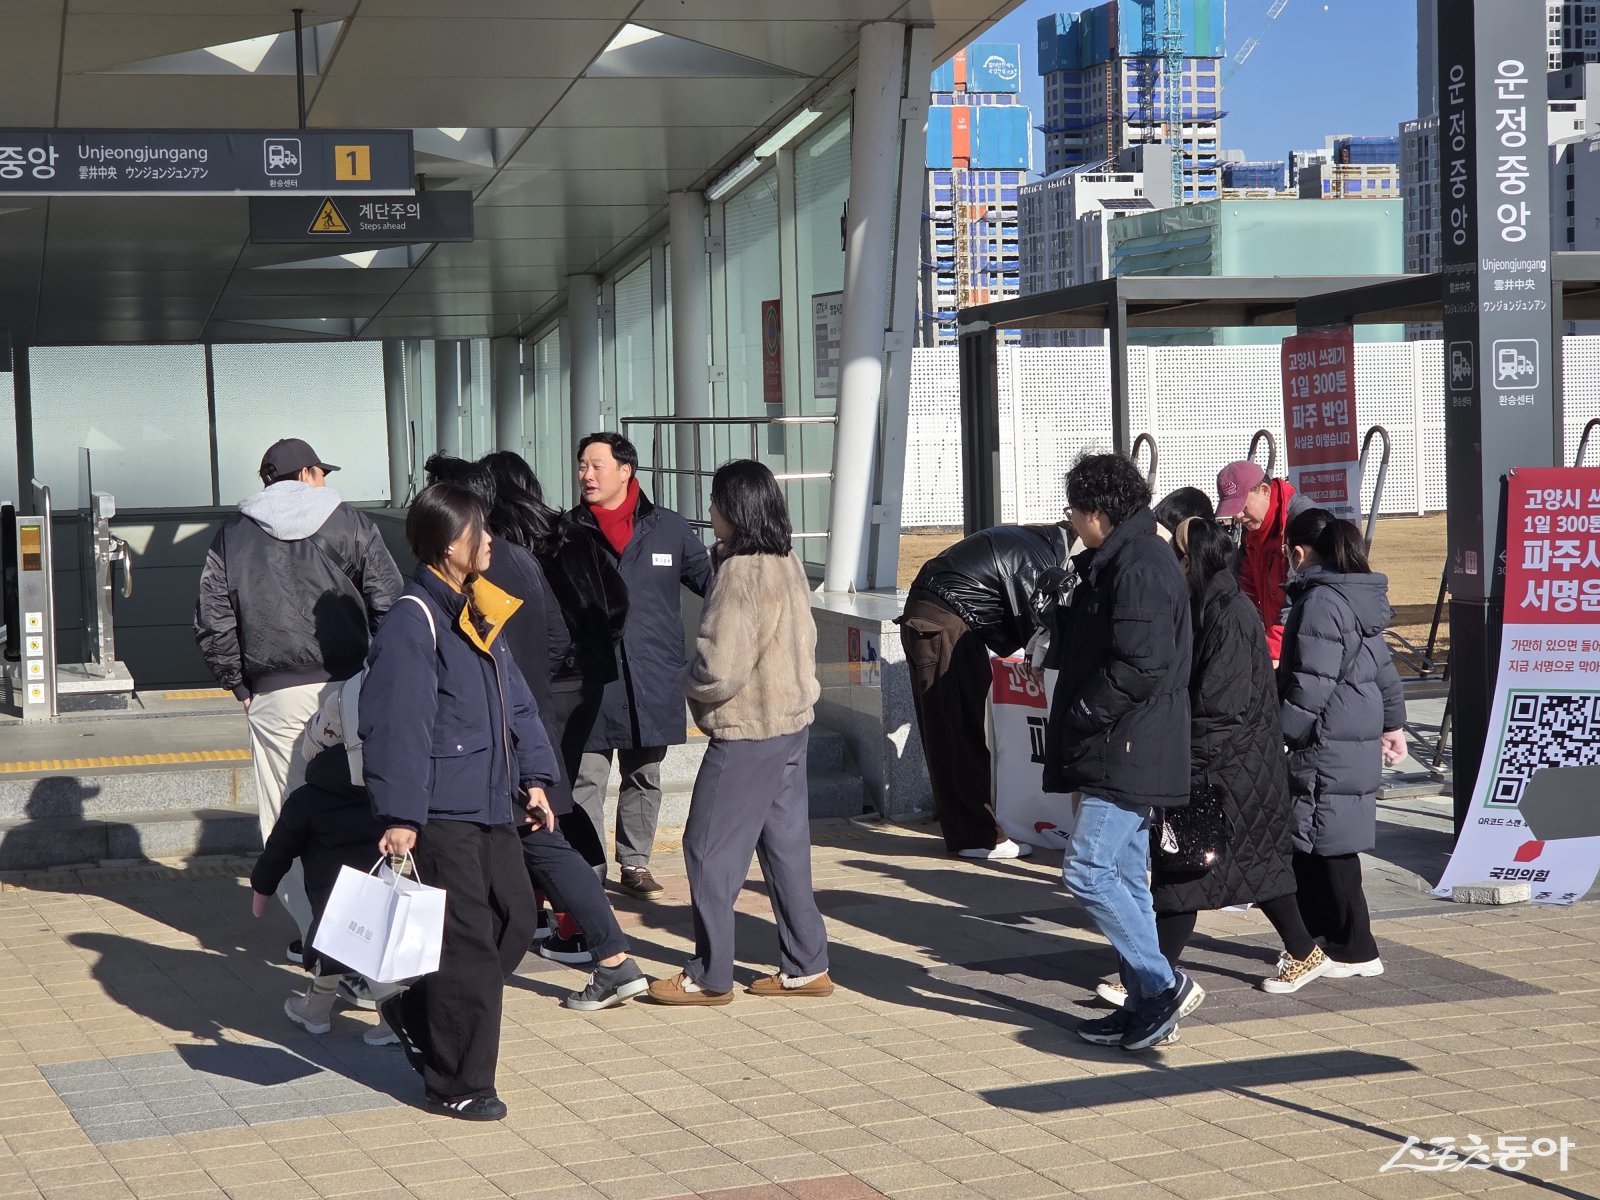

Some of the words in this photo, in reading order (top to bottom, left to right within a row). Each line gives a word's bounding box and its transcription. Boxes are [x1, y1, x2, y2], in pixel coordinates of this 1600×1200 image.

[78, 145, 208, 163] Unjeongjungang
[1448, 64, 1468, 246] 운정중앙
[1494, 59, 1531, 243] 운정중앙
[0, 145, 59, 179] 중앙
[346, 150, 357, 176] 1
[79, 165, 117, 180] 雲井中央
[269, 179, 298, 188] 환승센터
[359, 203, 420, 220] 계단주의
[360, 222, 381, 231] Steps
[382, 222, 406, 230] ahead
[1482, 258, 1546, 273] Unjeongjungang
[1289, 351, 1316, 371] 고양시
[1319, 346, 1346, 367] 쓰레기
[1291, 376, 1310, 398] 1일
[1313, 370, 1347, 395] 300톤
[1499, 395, 1534, 406] 환승센터
[1292, 403, 1318, 430] 파주
[1322, 399, 1349, 427] 반입
[1294, 434, 1314, 449] 사실은
[1315, 431, 1350, 447] 이렇습니다
[1524, 489, 1581, 510] 고양시
[1523, 515, 1551, 534] 1일
[1511, 639, 1542, 652] 가만히
[1546, 639, 1578, 652] 있으면
[1508, 660, 1529, 672] 지금
[1532, 660, 1574, 673] 서명으로
[1478, 817, 1504, 826] QR코드
[1505, 819, 1521, 828] 스캔
[1489, 866, 1550, 883] 국민의힘
